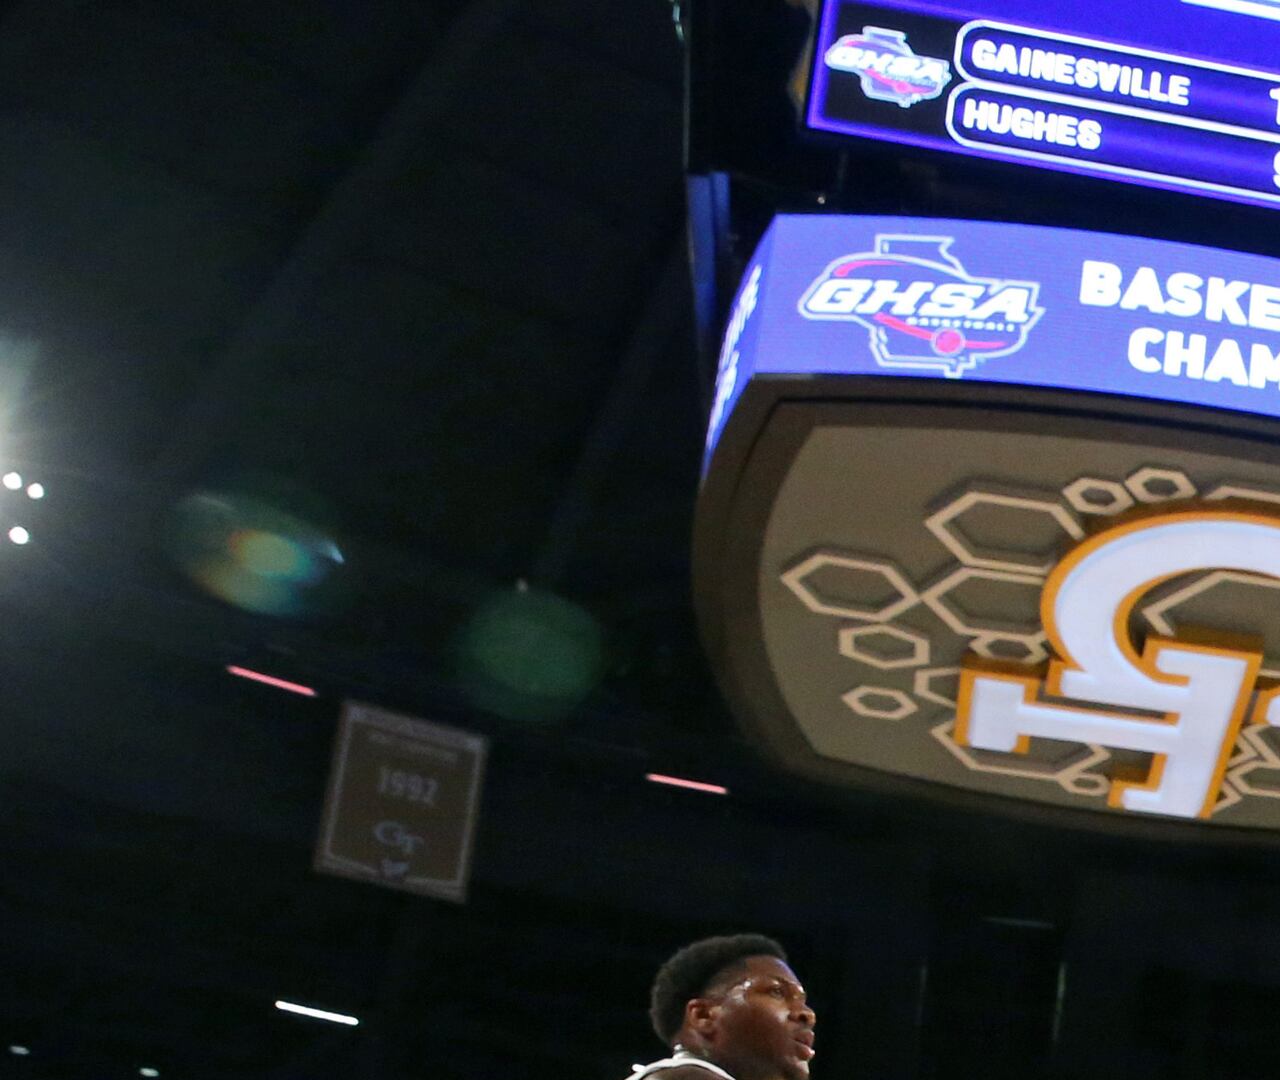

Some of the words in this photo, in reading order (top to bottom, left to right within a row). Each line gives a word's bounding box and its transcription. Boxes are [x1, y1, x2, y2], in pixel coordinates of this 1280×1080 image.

[829, 44, 946, 83] GHSA
[971, 39, 1191, 105] GAINESVILLE
[963, 99, 1102, 150] HUGHES
[806, 279, 1030, 323] GHSA
